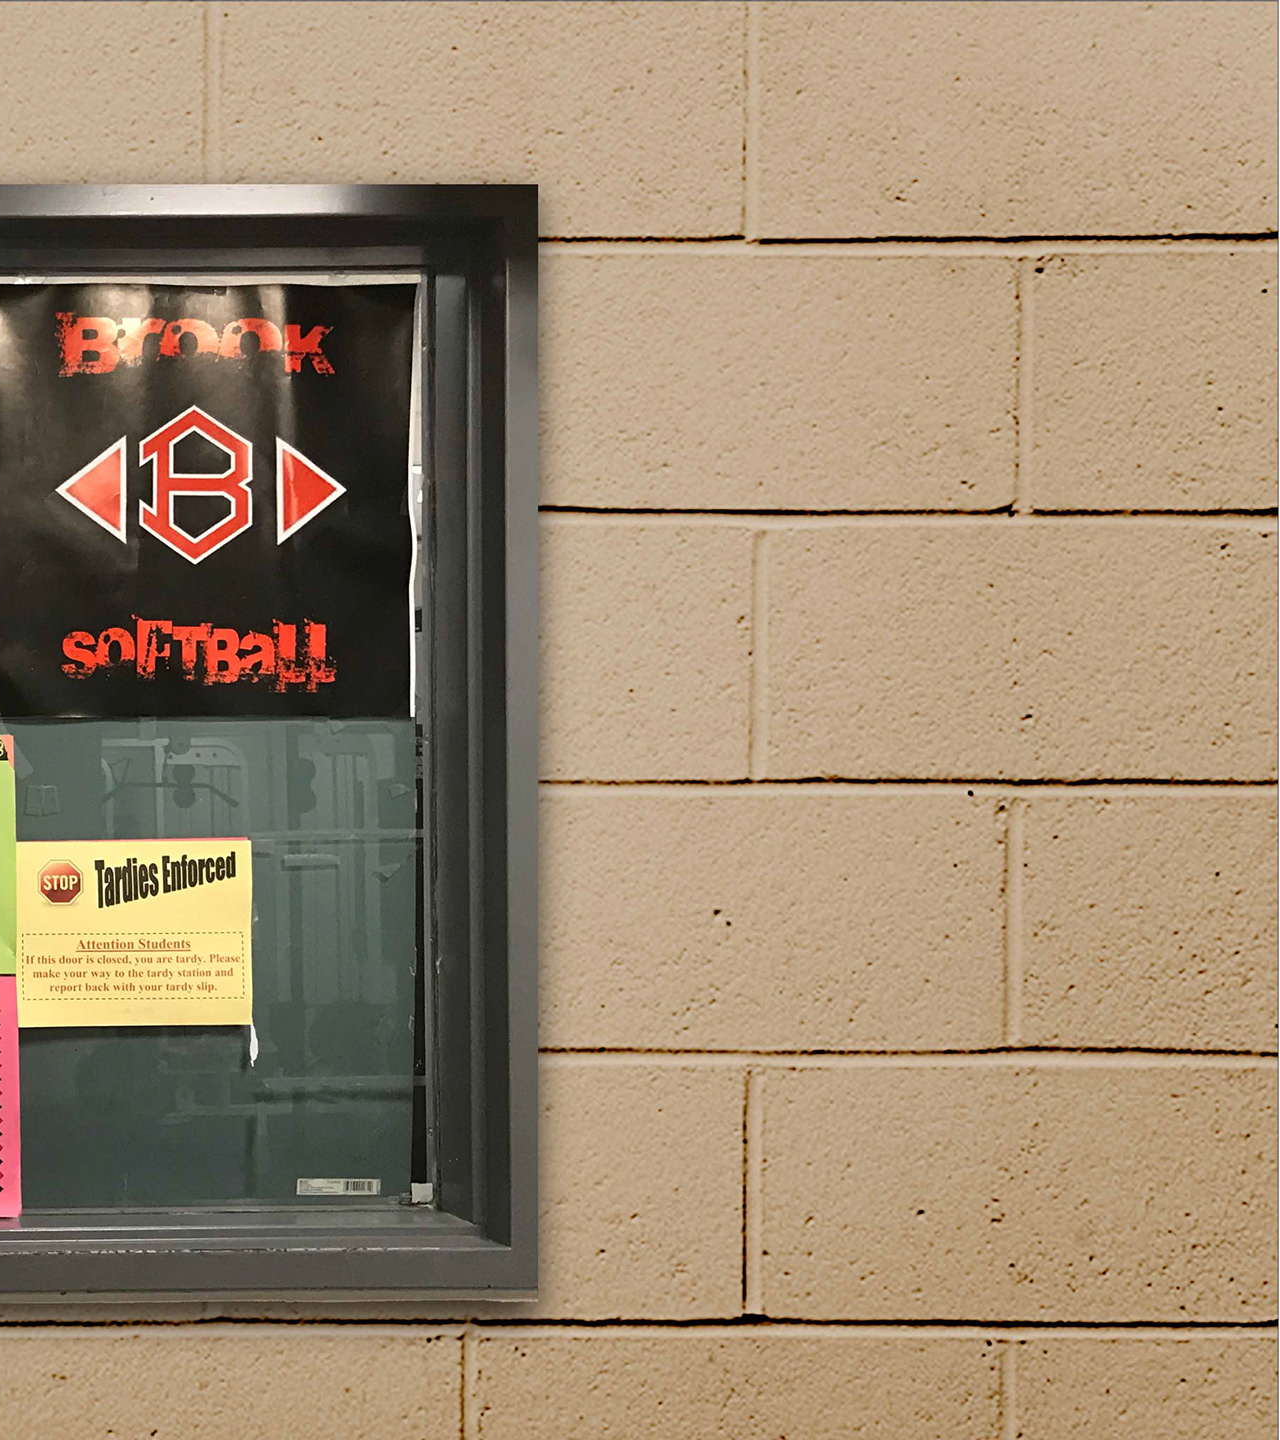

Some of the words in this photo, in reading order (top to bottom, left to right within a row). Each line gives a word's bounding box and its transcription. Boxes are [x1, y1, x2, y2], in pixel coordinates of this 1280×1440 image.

[43, 874, 78, 891] STOP
[94, 857, 159, 909] Tardies
[162, 851, 237, 894] Enforced
[76, 939, 134, 949] Attention
[138, 939, 191, 949] Students
[26, 955, 35, 964] If
[37, 955, 56, 964] this
[59, 955, 83, 964] door
[86, 955, 94, 964] is
[97, 955, 132, 964] closed,
[135, 957, 152, 966] you
[176, 954, 206, 965] tardy.
[209, 954, 240, 963] Please
[33, 969, 60, 978] make
[64, 971, 88, 980] your
[91, 971, 110, 980] way
[115, 970, 124, 978] to
[128, 969, 144, 977] the
[147, 968, 173, 980] tardy
[178, 968, 211, 977] station
[215, 968, 233, 977] and
[50, 983, 82, 994] report
[86, 983, 110, 991] back
[113, 983, 135, 991] with
[139, 984, 163, 994] your
[166, 982, 192, 993] tardy
[197, 982, 217, 993] slip.
